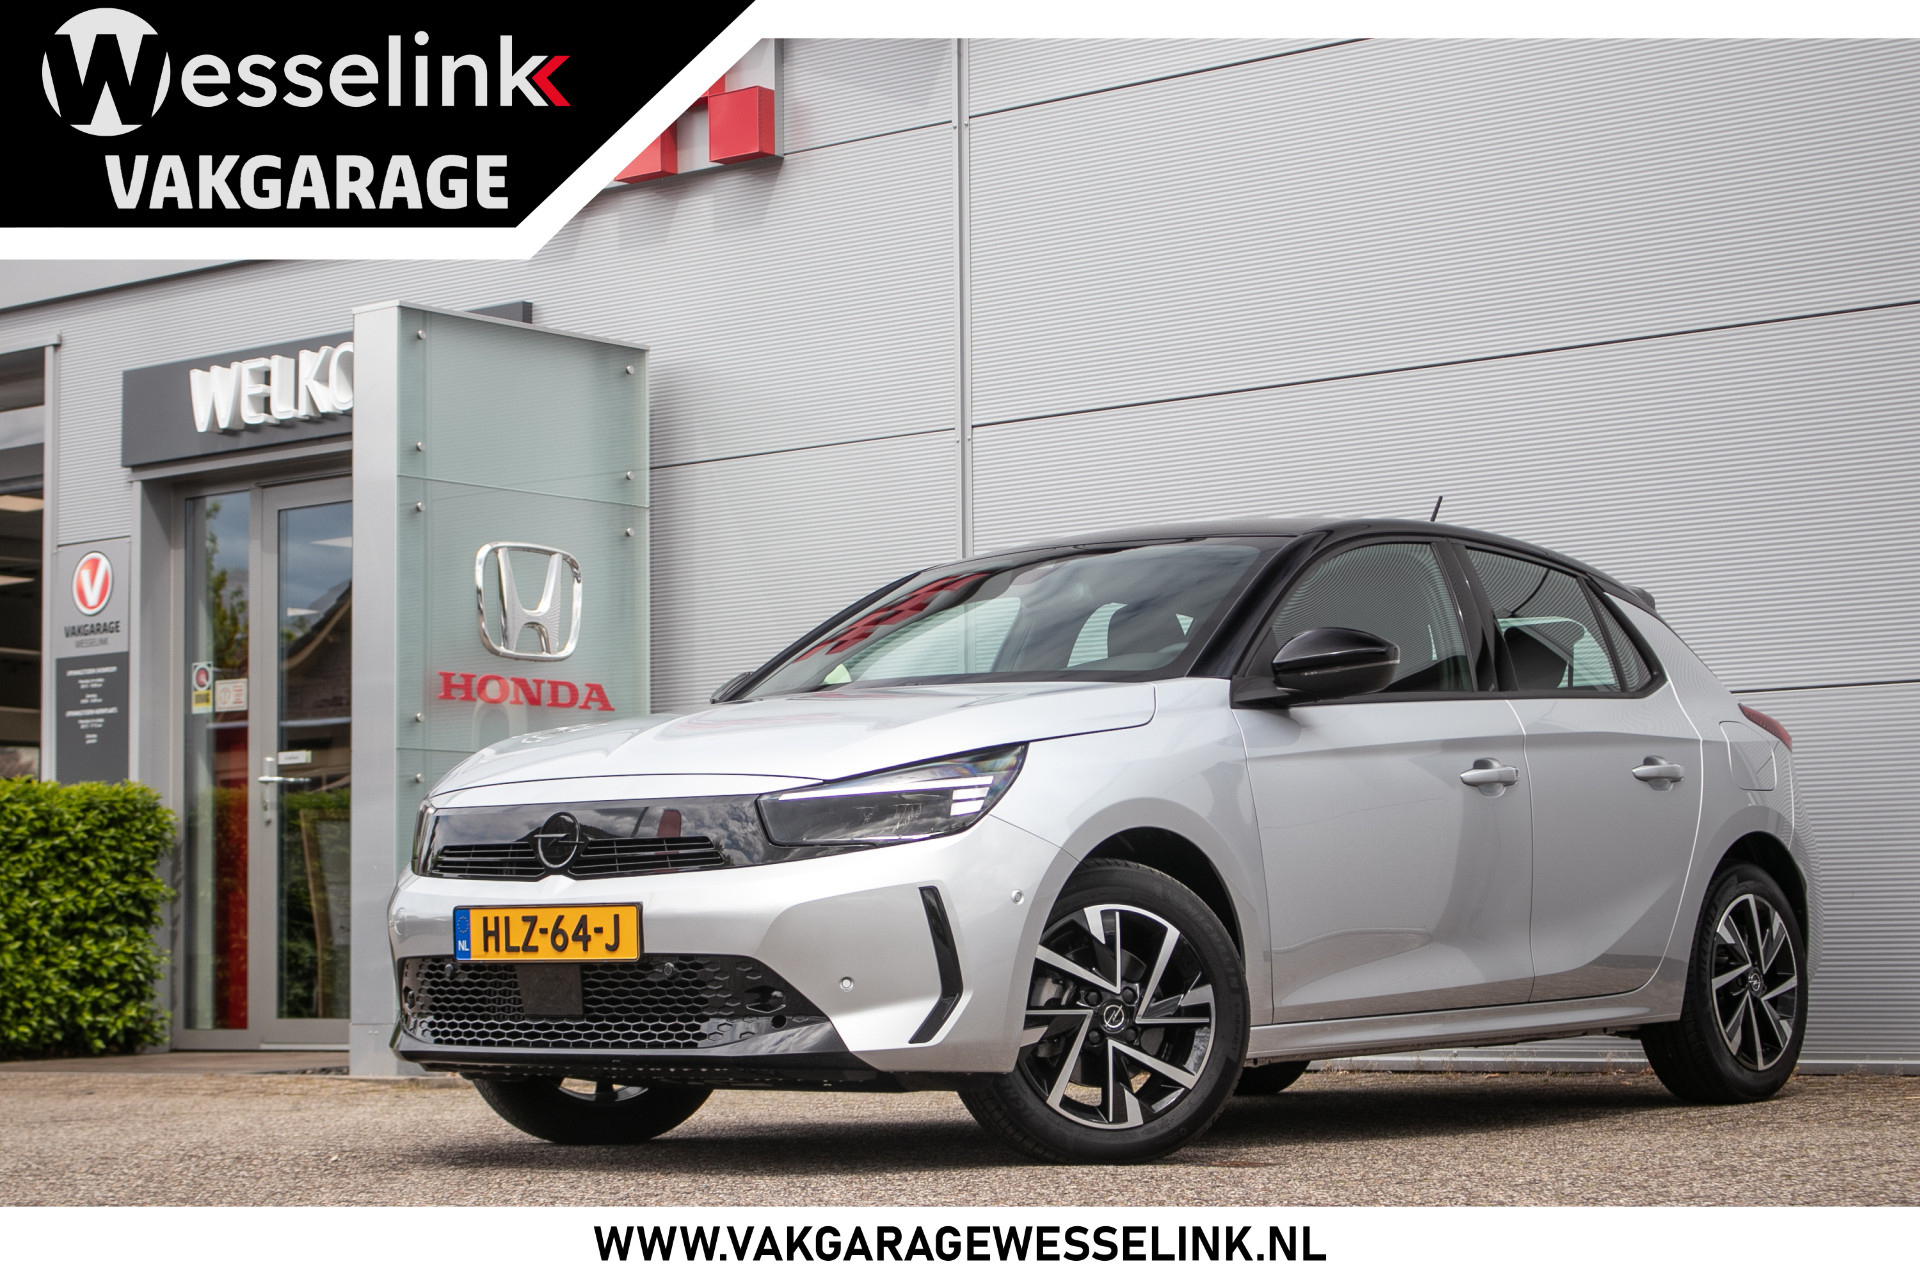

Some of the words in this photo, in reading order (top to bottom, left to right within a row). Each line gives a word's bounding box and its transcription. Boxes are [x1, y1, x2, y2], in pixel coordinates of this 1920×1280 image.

[64, 621, 120, 638] VAKGARAGE
[438, 671, 615, 711] HONDA
[457, 939, 470, 952] NL
[483, 914, 620, 952] HLZ-64-J
